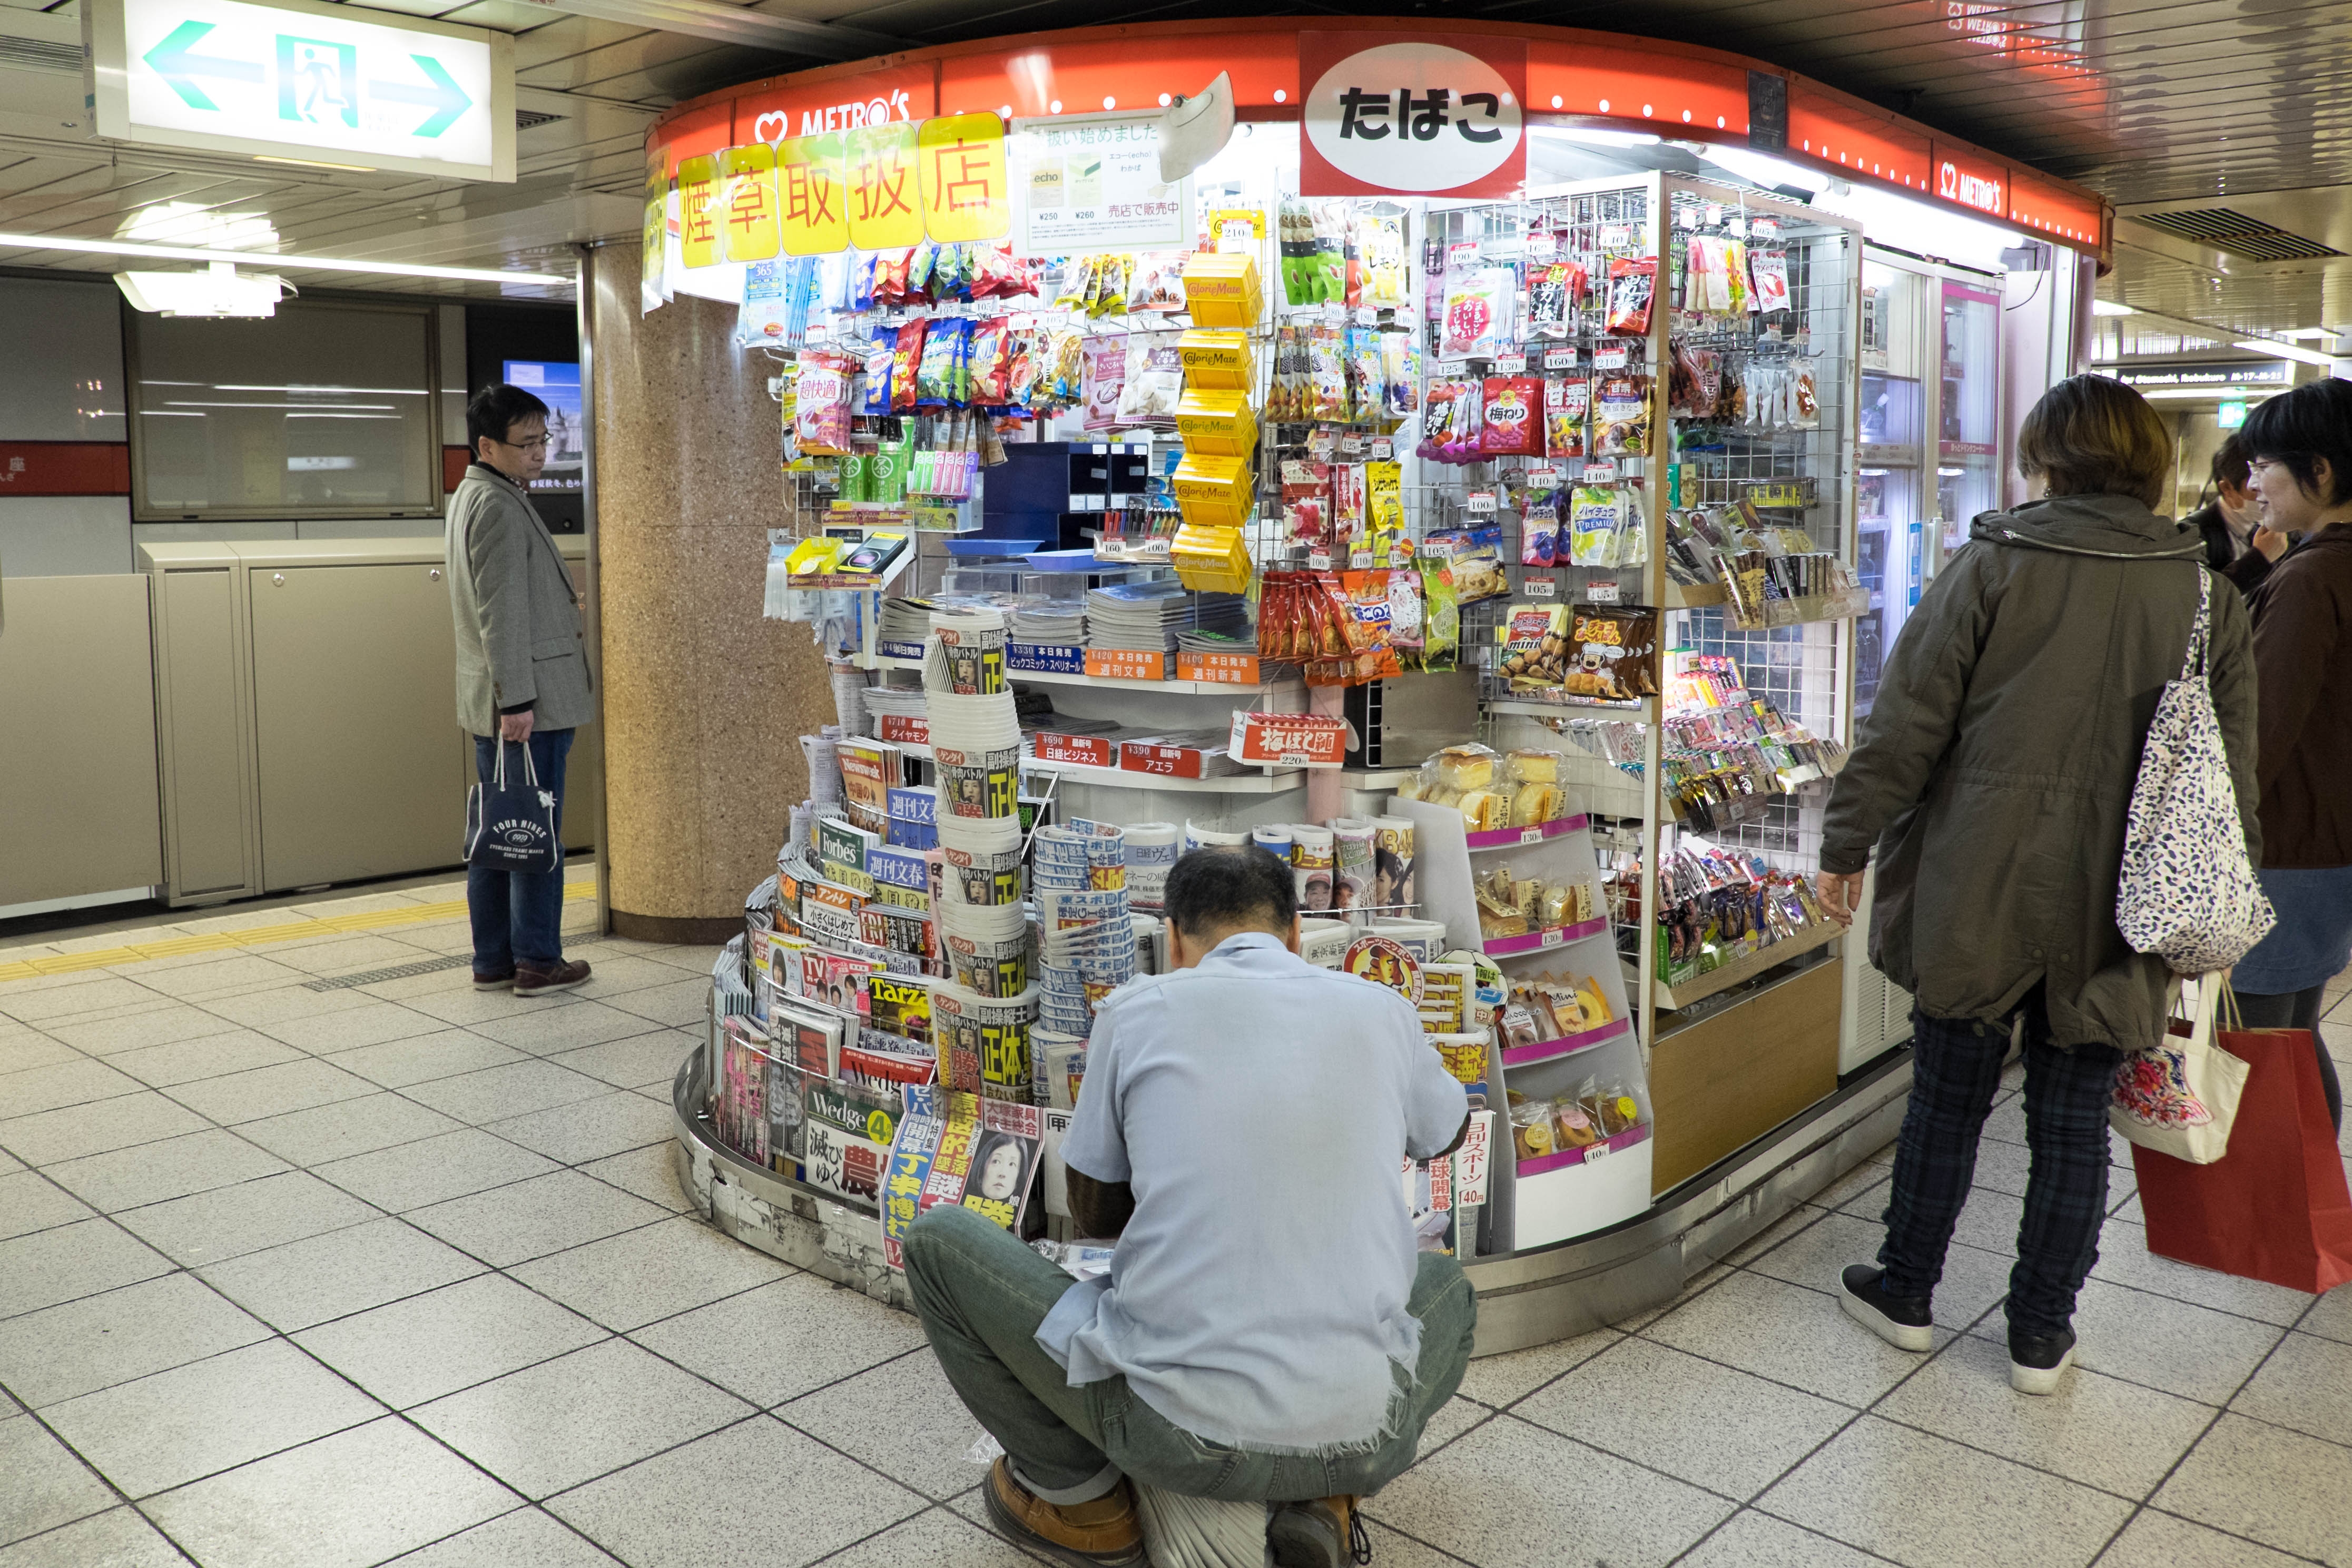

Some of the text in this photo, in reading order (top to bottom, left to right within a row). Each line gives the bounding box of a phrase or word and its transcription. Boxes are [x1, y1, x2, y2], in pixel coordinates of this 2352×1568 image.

[801, 88, 910, 137] METRO'S
[1340, 87, 1503, 143] たばこ
[1034, 172, 1058, 182] echo
[684, 138, 990, 245] 煙草取扱店
[1960, 173, 2001, 214] METRO'S
[1076, 211, 1094, 219] ¥260
[1108, 201, 1179, 218] 売店で販売中
[756, 264, 773, 277] 365
[1187, 282, 1241, 297] CalorieMate
[923, 342, 955, 354] OREO
[1184, 352, 1237, 365] CalorieMate
[800, 380, 837, 400] 超快適
[1547, 383, 1587, 406] 甘栗
[1611, 383, 1631, 393] 甘栗
[1489, 407, 1524, 421] 梅ねり
[1181, 420, 1234, 432] CalorieMate
[843, 458, 858, 474] 茶
[874, 457, 891, 475] 茶
[1178, 485, 1231, 498] CalorieMate
[1528, 509, 1554, 519] ハイチュウ
[1579, 506, 1616, 517] ハイチュウ
[1176, 556, 1229, 569] CalorieMate
[1528, 585, 1552, 594] 105円
[1588, 620, 1616, 632] チョコ
[1508, 636, 1542, 650] mini
[1038, 647, 1072, 658] 本日発売
[1117, 653, 1153, 664] 本日発売
[1211, 656, 1248, 667] 本日発売
[1100, 663, 1146, 678] 週刊文春
[1193, 668, 1242, 683] 週刊新潮
[1071, 738, 1092, 748] 最新号
[1046, 748, 1098, 764] 日経ビジネス
[1159, 748, 1182, 760] 最新号
[1282, 756, 1307, 766] 220円
[1145, 758, 1174, 773] アエラ
[951, 767, 984, 780] 骨肉バトル
[493, 819, 547, 839] FOUR NINES
[822, 832, 857, 864] Forbes
[869, 856, 924, 885] 週刊文春
[819, 887, 847, 904] アントレ
[1061, 894, 1104, 905] 東スポ
[810, 910, 855, 933] 小さくはじめて
[755, 932, 769, 945] NHK
[756, 944, 769, 960] ステラ
[1353, 938, 1412, 963] スポーツニッポン
[804, 956, 824, 978] TV
[1070, 958, 1113, 970] 東スポ
[1549, 990, 1579, 1005] Mini
[949, 1014, 978, 1030] 骨肉バトル
[980, 1007, 1028, 1026] 副操縦士
[982, 1024, 1024, 1086] 正体
[910, 1084, 933, 1116] セ・パ
[812, 1090, 867, 1130] Wedge
[987, 1100, 1038, 1122] 大塚家具
[908, 1113, 932, 1126] 同時
[987, 1114, 1038, 1137] 株主総会
[870, 1114, 887, 1141] 4
[900, 1122, 924, 1153] 開幕
[810, 1126, 843, 1166] 滅び
[1461, 1122, 1486, 1185] 日刊スポーツ
[815, 1163, 840, 1191] ゆく
[1458, 1189, 1484, 1206] 140円
